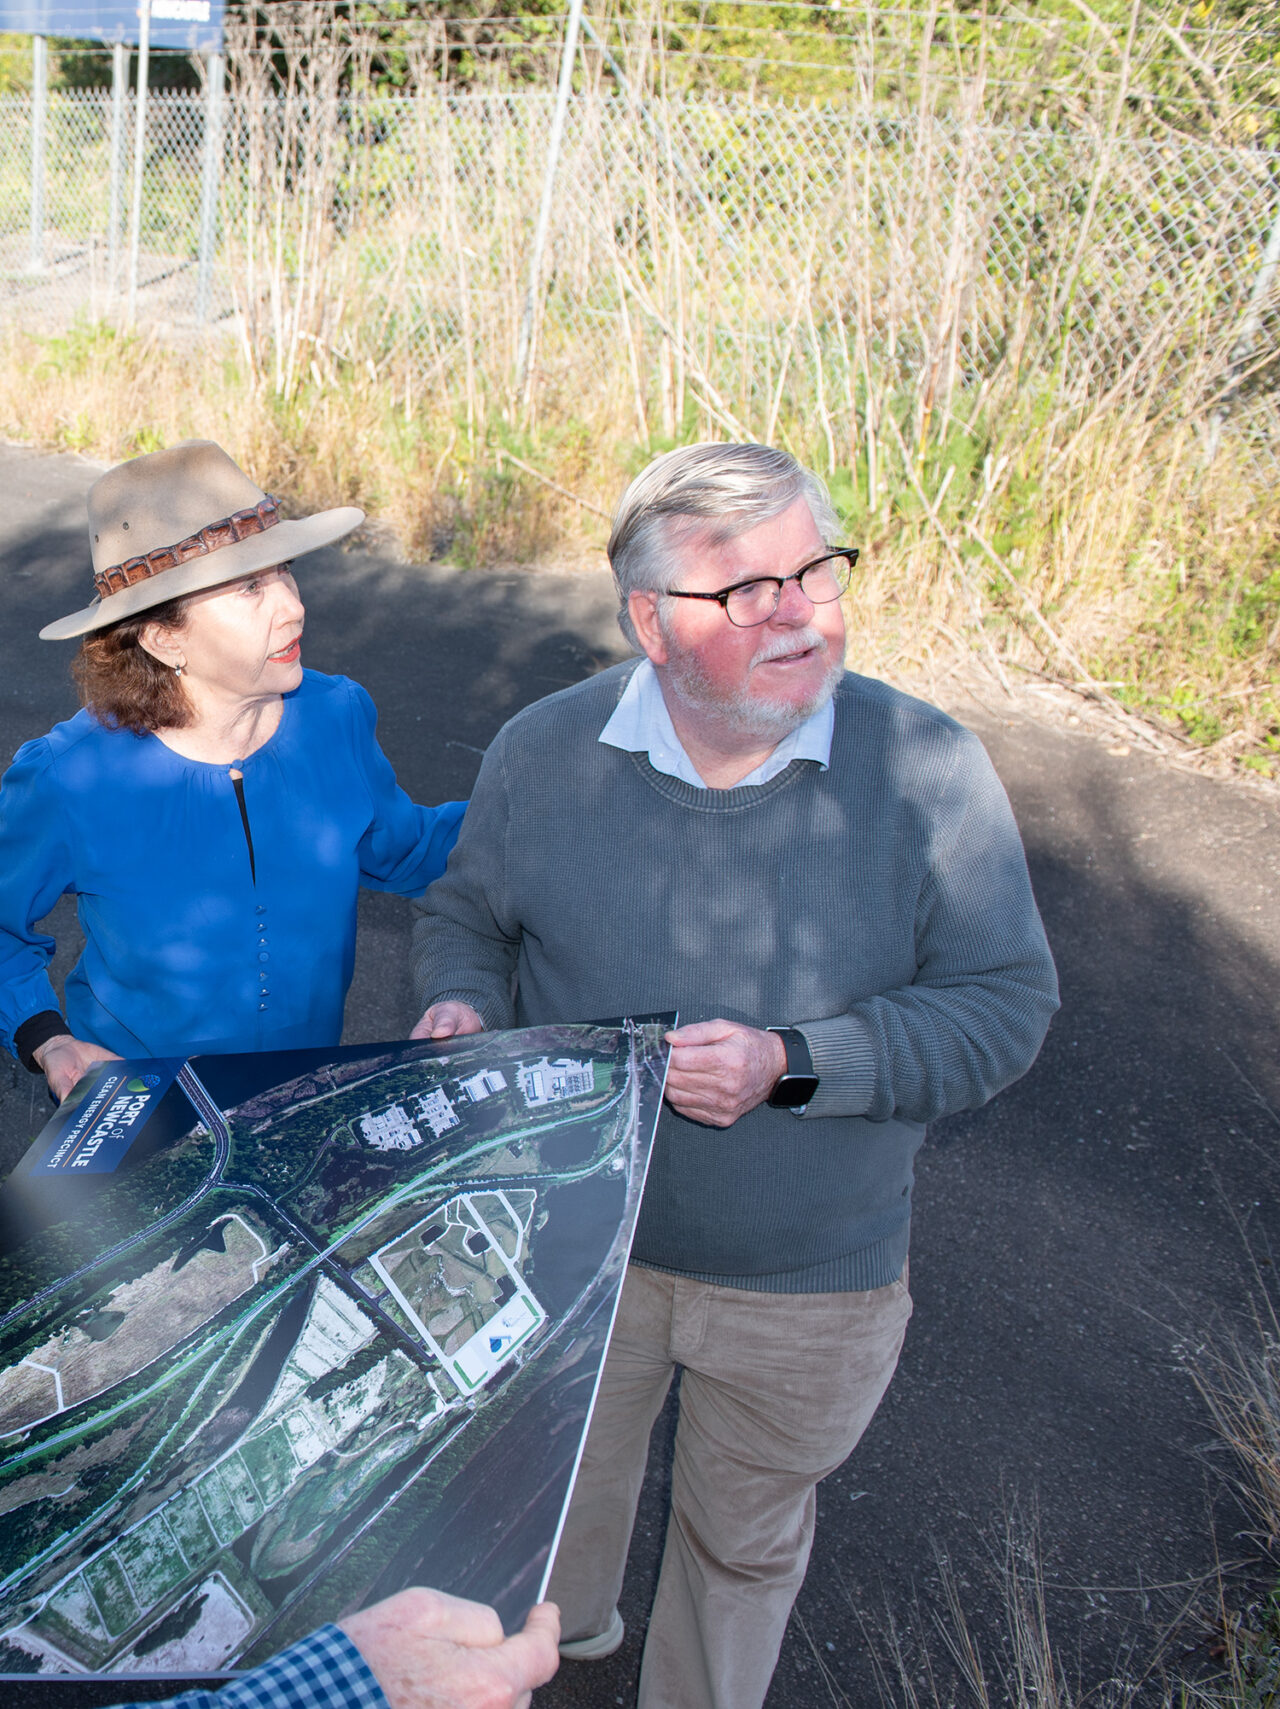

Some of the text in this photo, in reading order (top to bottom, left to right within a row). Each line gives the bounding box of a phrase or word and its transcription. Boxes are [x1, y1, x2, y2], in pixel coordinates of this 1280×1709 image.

[47, 1076, 118, 1169] CLEAN ENERGY PRECINCT
[71, 1095, 129, 1168] NEWCASTLE
[108, 1094, 151, 1139] PORT of
